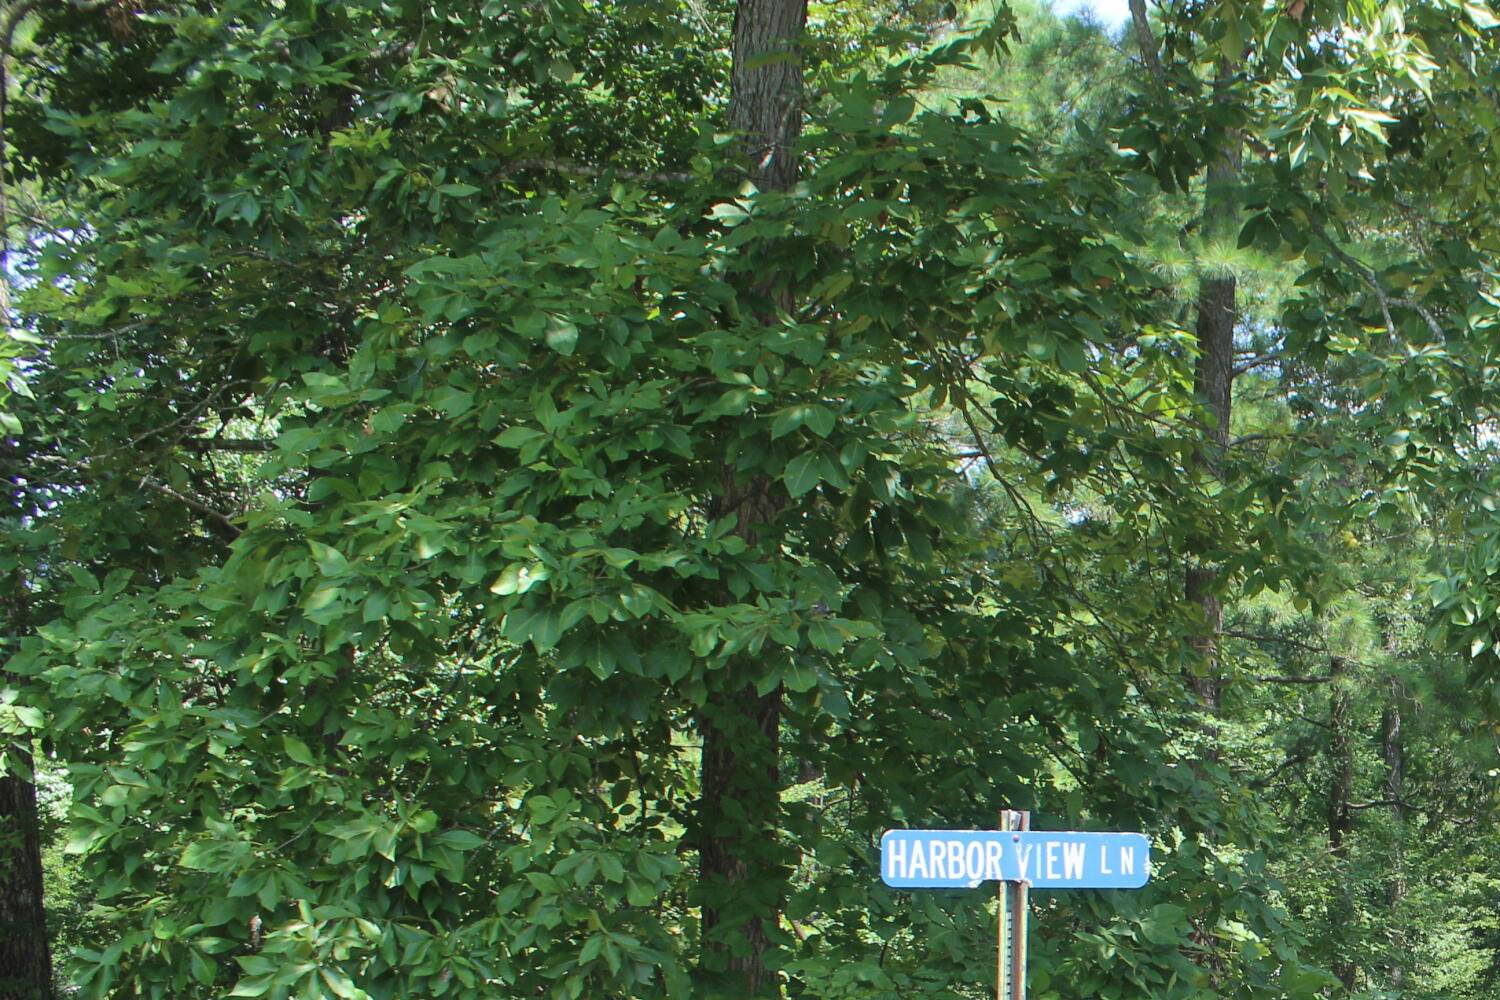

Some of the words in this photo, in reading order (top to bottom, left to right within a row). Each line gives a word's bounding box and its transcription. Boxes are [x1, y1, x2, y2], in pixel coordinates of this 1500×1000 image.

[888, 839, 1002, 879] HARBOR
[1015, 842, 1086, 880] VIEW
[1100, 847, 1135, 875] LN
